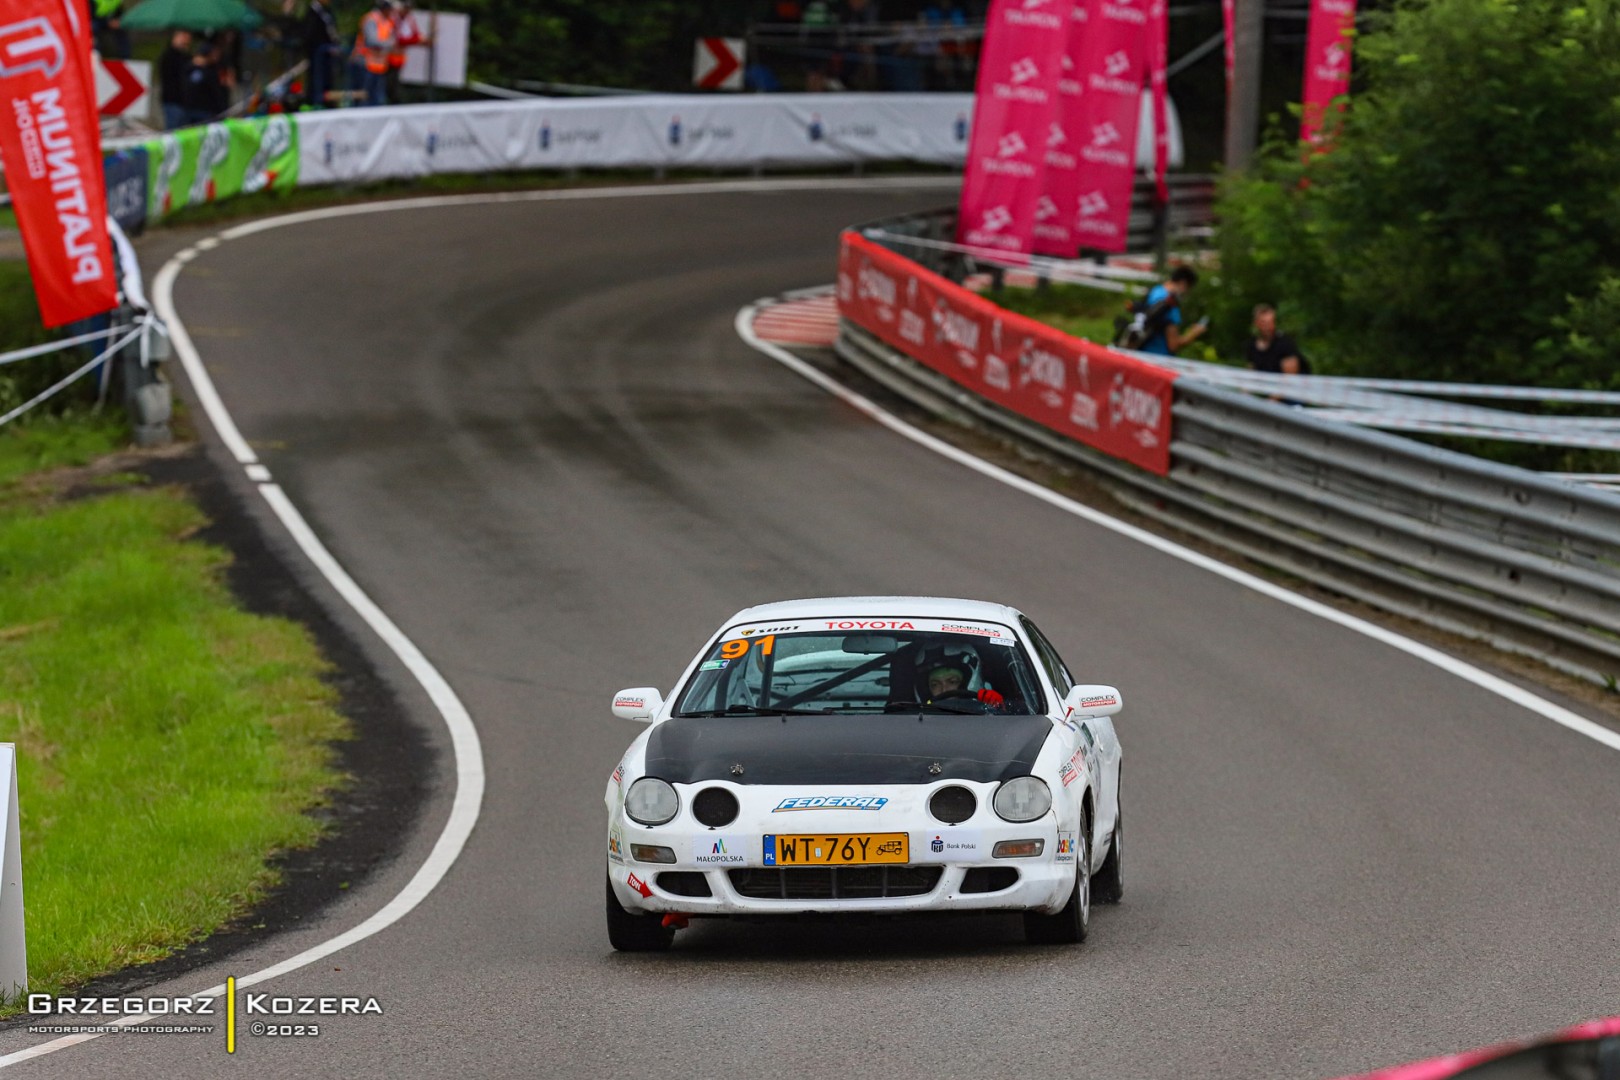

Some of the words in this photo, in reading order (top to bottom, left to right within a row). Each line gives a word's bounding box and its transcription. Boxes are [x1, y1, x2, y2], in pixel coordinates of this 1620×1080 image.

[825, 621, 914, 630] TOYOTA
[721, 634, 775, 660] 91
[1081, 694, 1115, 702] COMPLEX
[777, 797, 886, 809] FEDERAL
[780, 838, 815, 862] WT
[825, 837, 871, 862] 76Y
